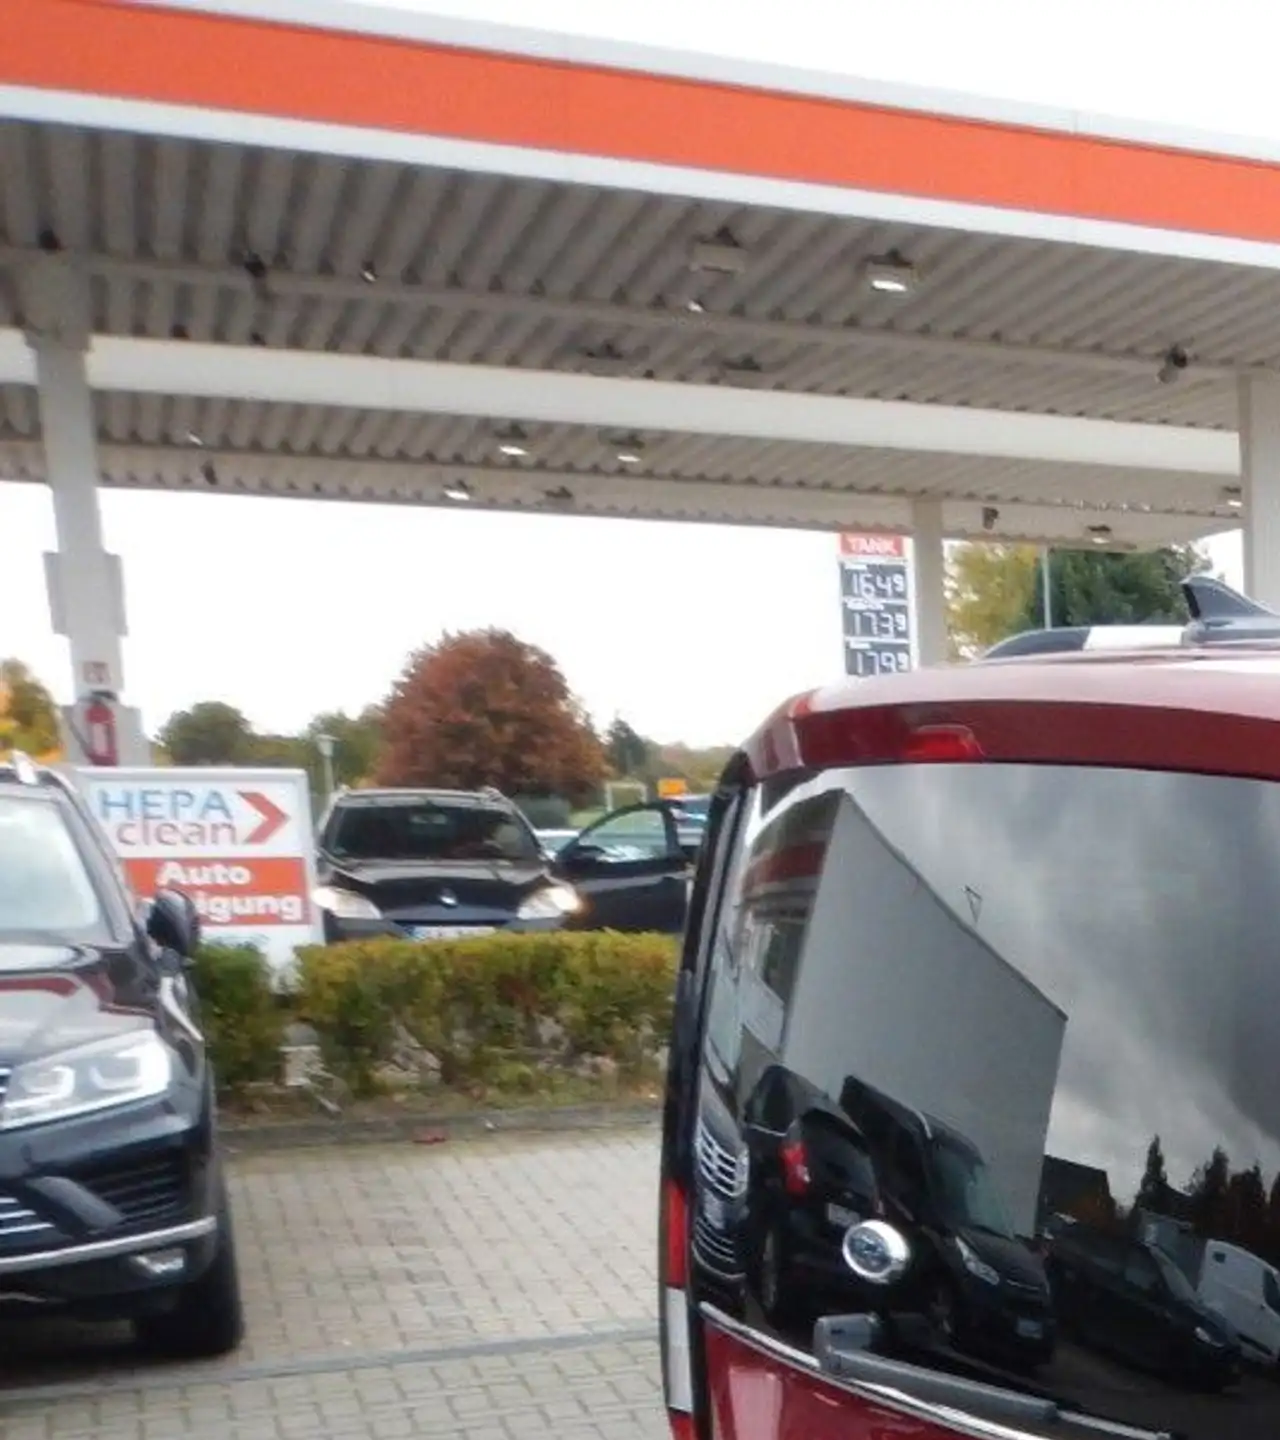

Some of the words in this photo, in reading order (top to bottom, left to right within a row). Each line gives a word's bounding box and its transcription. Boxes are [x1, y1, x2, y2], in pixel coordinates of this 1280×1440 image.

[100, 789, 233, 820] HEPA
[116, 817, 237, 845] clean
[156, 861, 251, 885] Auto
